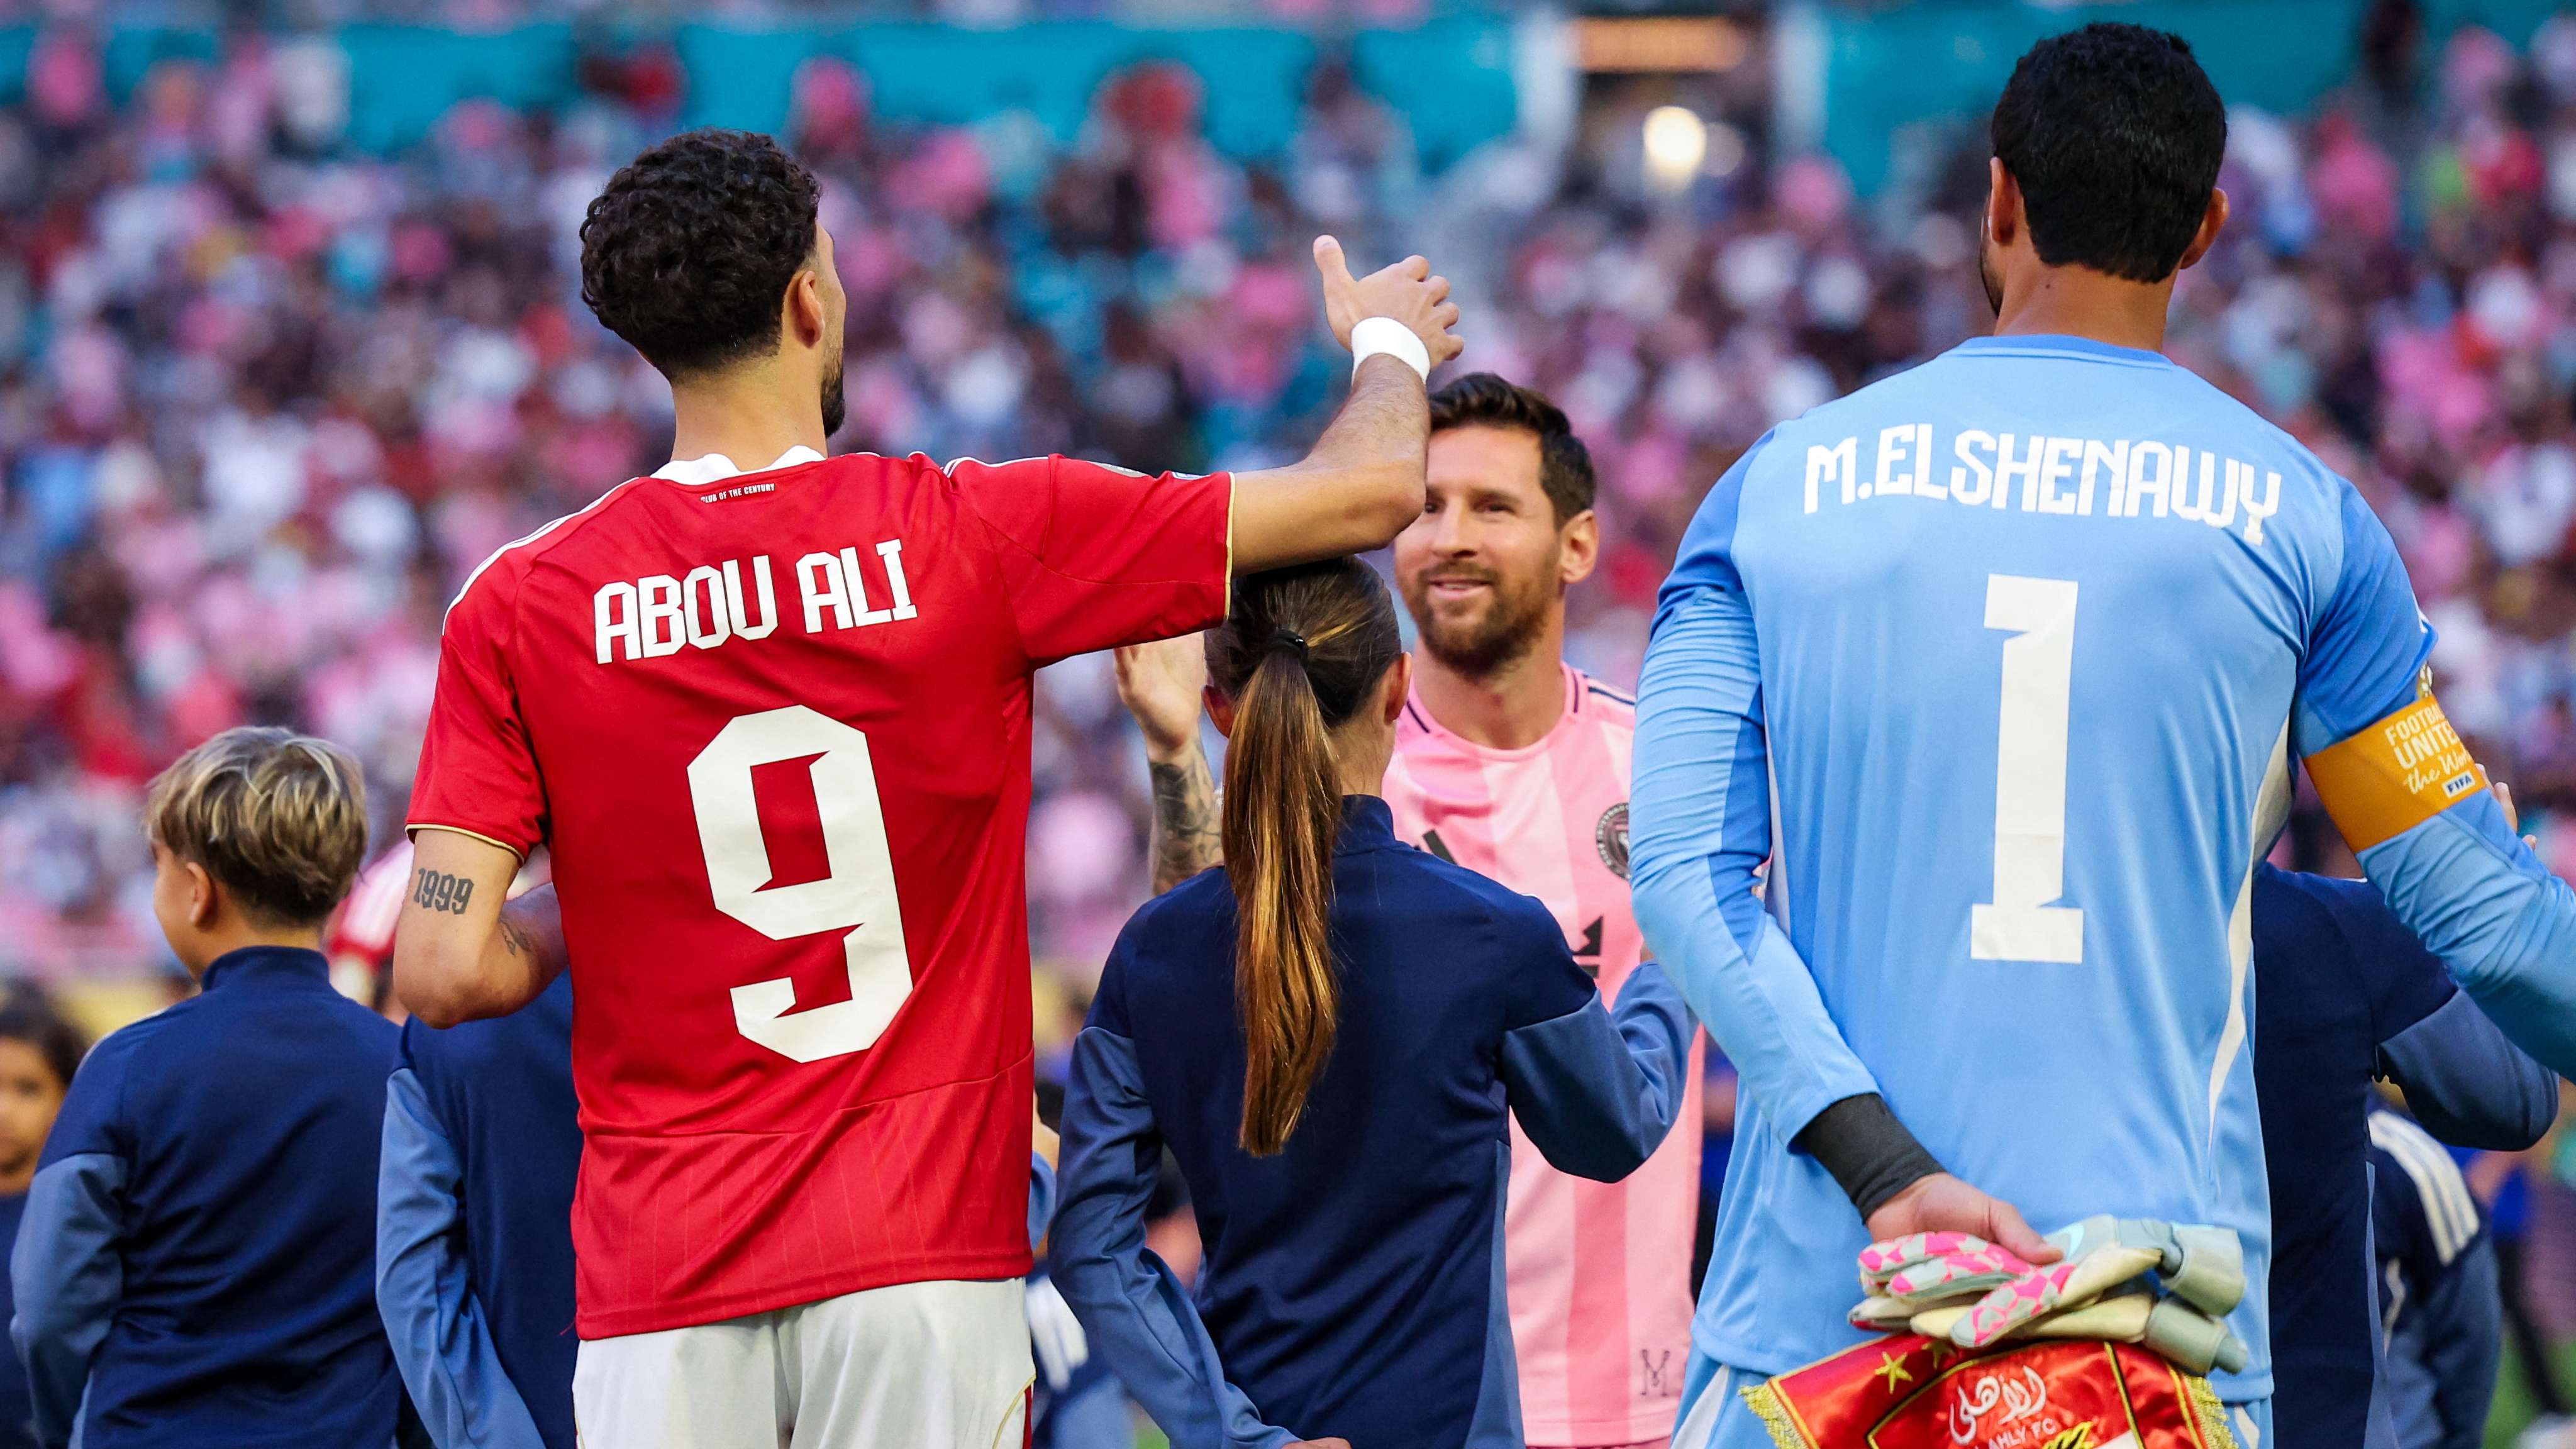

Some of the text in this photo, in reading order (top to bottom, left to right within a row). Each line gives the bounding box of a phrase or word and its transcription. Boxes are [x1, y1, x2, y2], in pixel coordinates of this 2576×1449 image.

[719, 491, 727, 500] OF
[729, 488, 742, 497] THE
[744, 483, 775, 494] CENTURY
[1804, 423, 2282, 547] M.ELSHENAWY
[594, 538, 918, 665] ABOU ALI
[1970, 574, 2084, 963] 1
[2404, 767, 2441, 795] the
[2446, 775, 2473, 794] FIFA
[413, 867, 475, 915] 1999
[686, 704, 914, 1063] 9
[2030, 1418, 2057, 1440] FC
